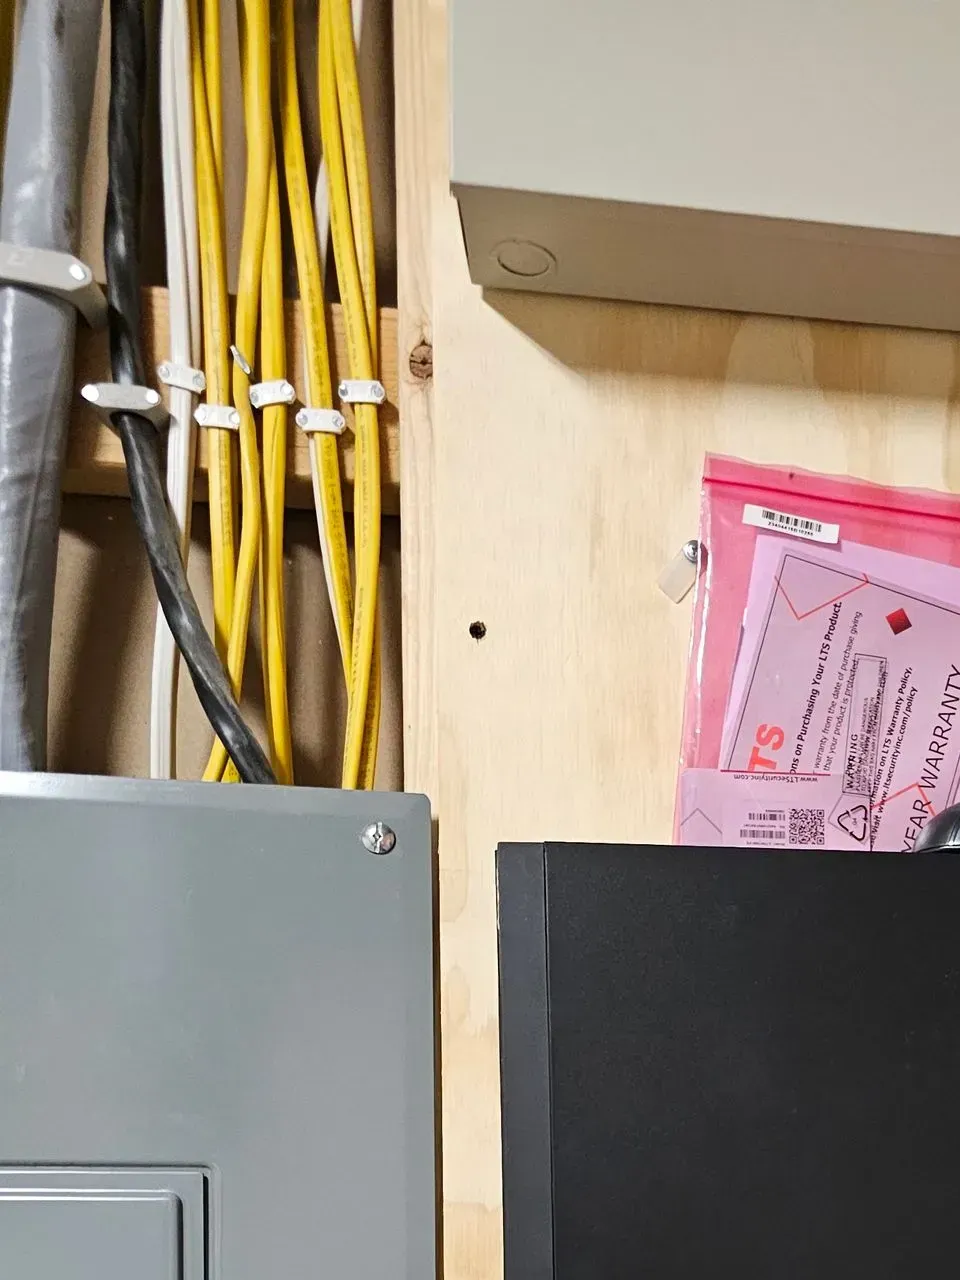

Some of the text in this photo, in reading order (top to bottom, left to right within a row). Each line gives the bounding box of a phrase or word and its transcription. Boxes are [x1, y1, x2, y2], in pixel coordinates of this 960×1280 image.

[824, 602, 842, 641] Product.
[819, 643, 830, 661] LTS
[811, 663, 824, 685] Your
[898, 667, 912, 694] Policy,
[815, 611, 863, 768] warranty from the date of purchase giving
[797, 689, 820, 741] Purchasing
[886, 696, 904, 735] Warranty
[795, 744, 803, 756] on
[823, 756, 833, 771] that
[829, 736, 838, 753] your
[834, 706, 847, 736] product
[881, 738, 891, 754] LTS
[879, 756, 887, 767] on
